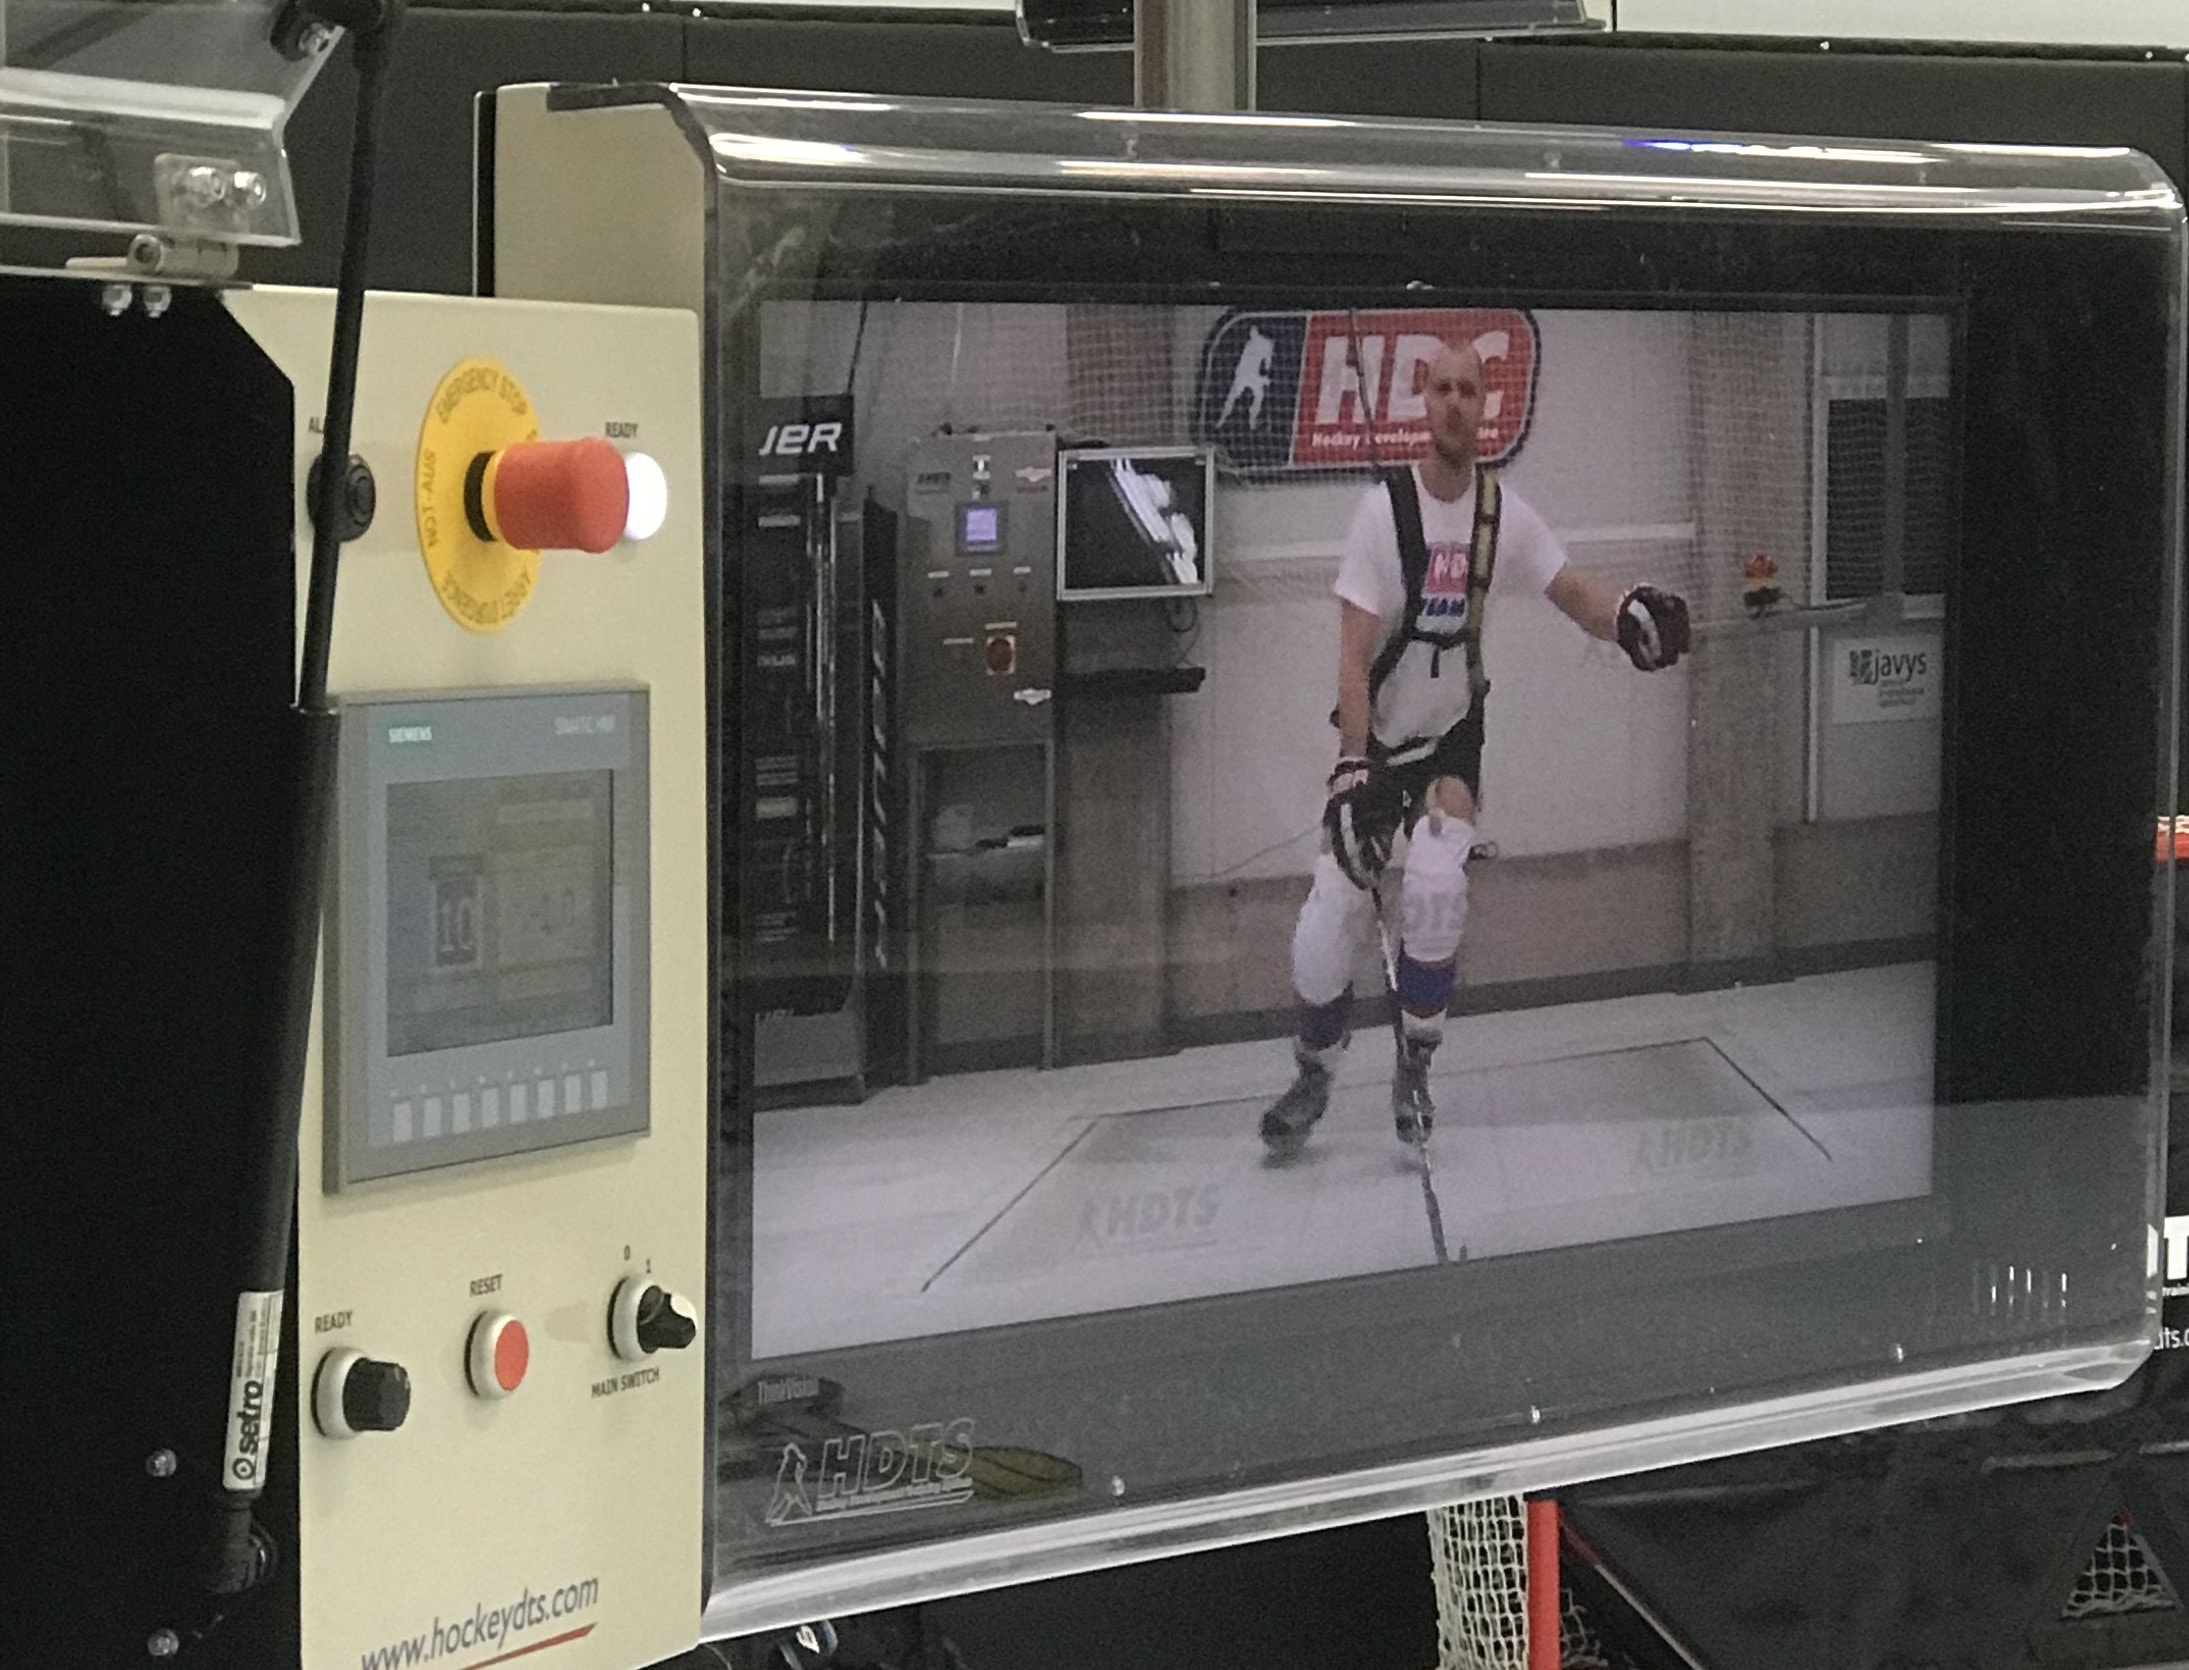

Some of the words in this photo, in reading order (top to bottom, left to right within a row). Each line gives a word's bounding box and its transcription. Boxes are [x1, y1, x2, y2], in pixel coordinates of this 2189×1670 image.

[605, 421, 638, 439] READY
[1873, 649, 1927, 686] javys
[1106, 1181, 1222, 1237] HDTS
[469, 1273, 502, 1297] RESET
[315, 1309, 353, 1334] READY
[592, 1375, 619, 1398] MAIN
[620, 1366, 660, 1391] SWITCH
[816, 1417, 976, 1498] HDTS
[361, 1577, 599, 1670] www.hockeydts.com
